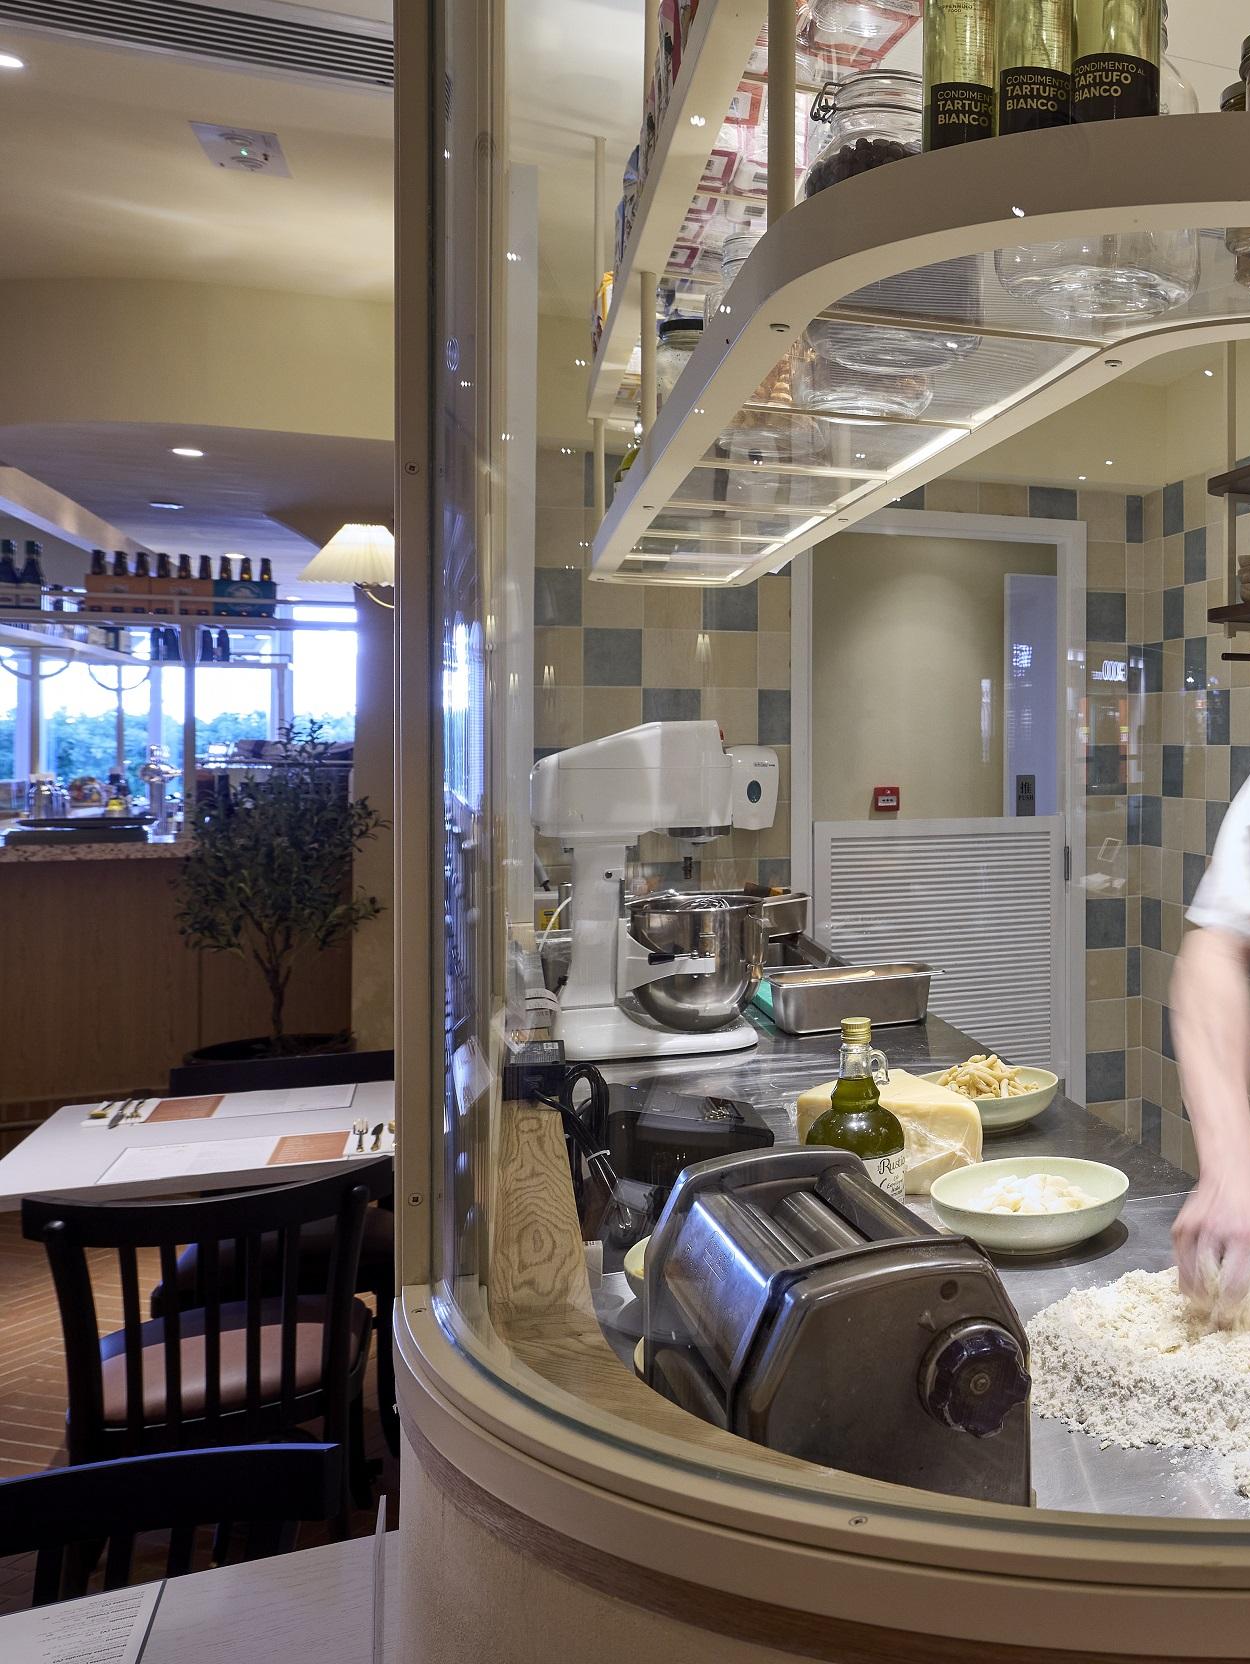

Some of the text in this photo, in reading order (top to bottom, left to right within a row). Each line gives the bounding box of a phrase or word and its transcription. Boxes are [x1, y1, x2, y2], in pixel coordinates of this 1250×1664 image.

[1074, 61, 1136, 77] CONDIMENTO
[1006, 74, 1070, 89] CONDIMENTO
[1075, 72, 1131, 89] TARTUFO
[1006, 85, 1066, 100] TARTUFO
[1074, 85, 1121, 103] BIANCO
[1006, 98, 1058, 112] BIANCO
[938, 113, 989, 127] BIANCO
